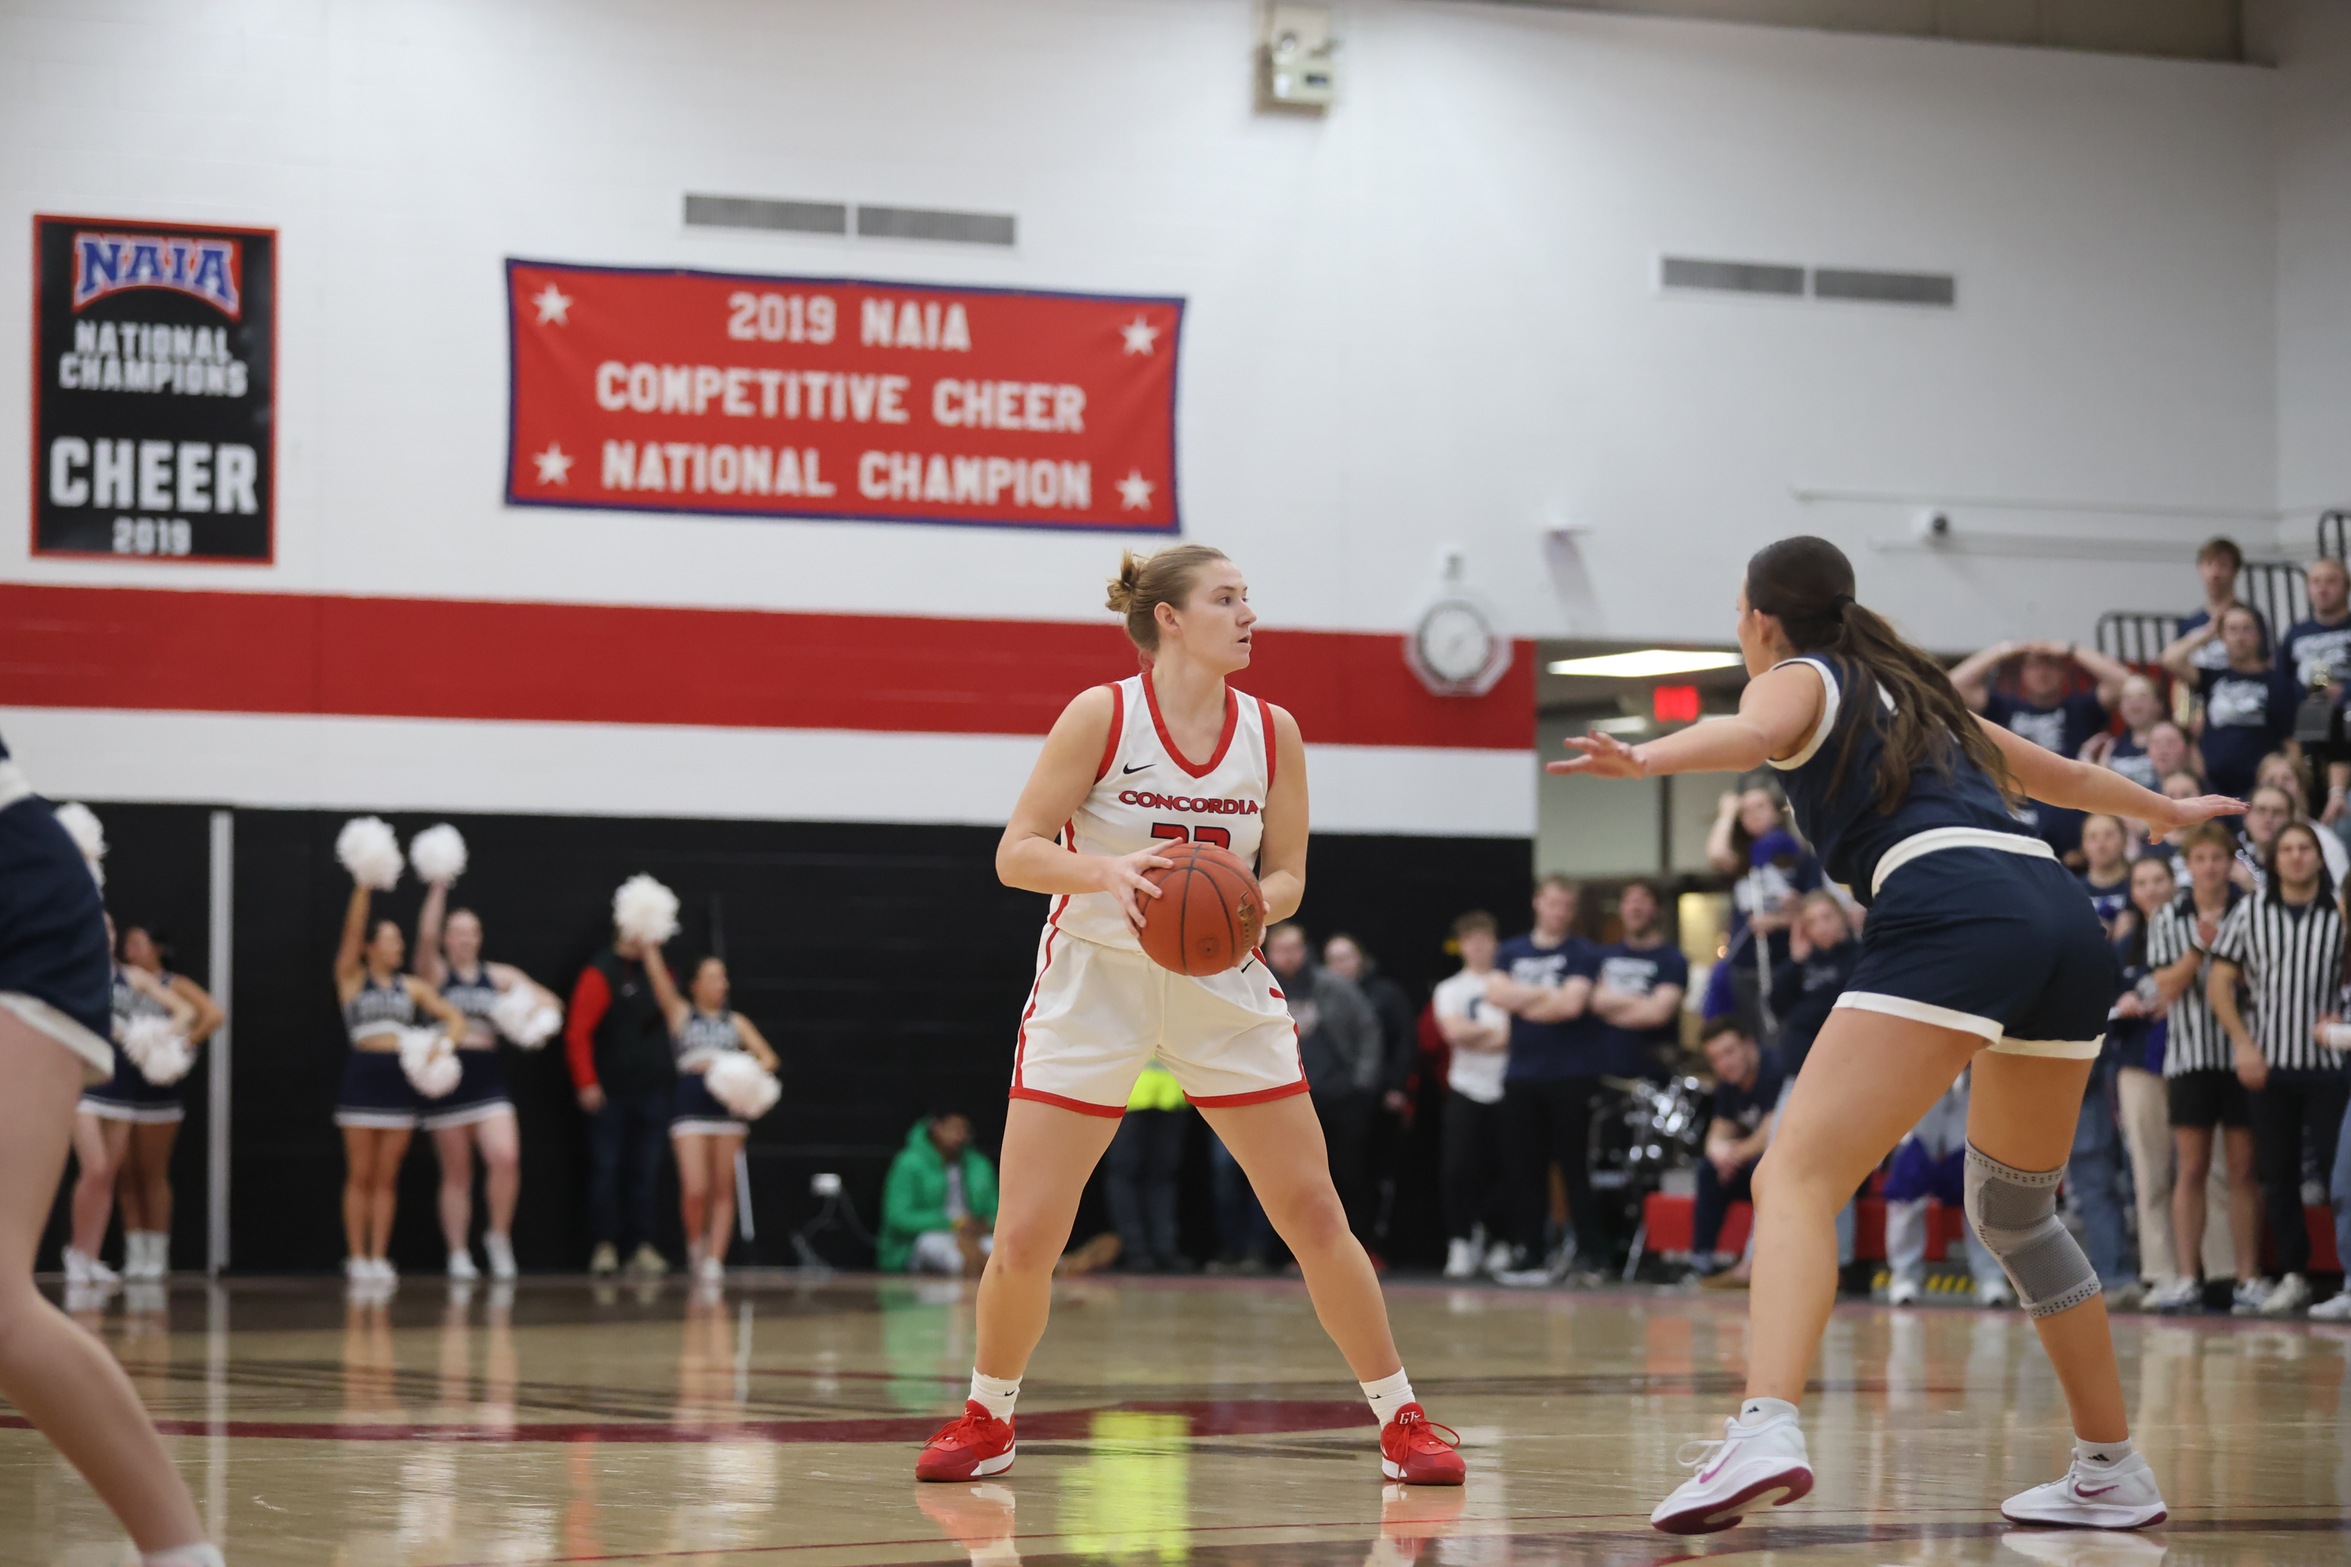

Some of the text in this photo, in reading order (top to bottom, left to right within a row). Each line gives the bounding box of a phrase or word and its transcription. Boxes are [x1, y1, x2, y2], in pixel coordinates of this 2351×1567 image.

[77, 234, 239, 309] NAIA
[74, 319, 233, 364] NATIONAL
[728, 291, 972, 352] 2019 NAIA
[59, 352, 248, 398] CHAMPIONS
[596, 360, 1087, 433] COMPETITIVE CHEER
[49, 435, 259, 515] CHEER
[601, 439, 1092, 511] NATIONAL CHAMPION
[111, 517, 192, 556] 2019
[1119, 790, 1259, 815] CONCORDIA
